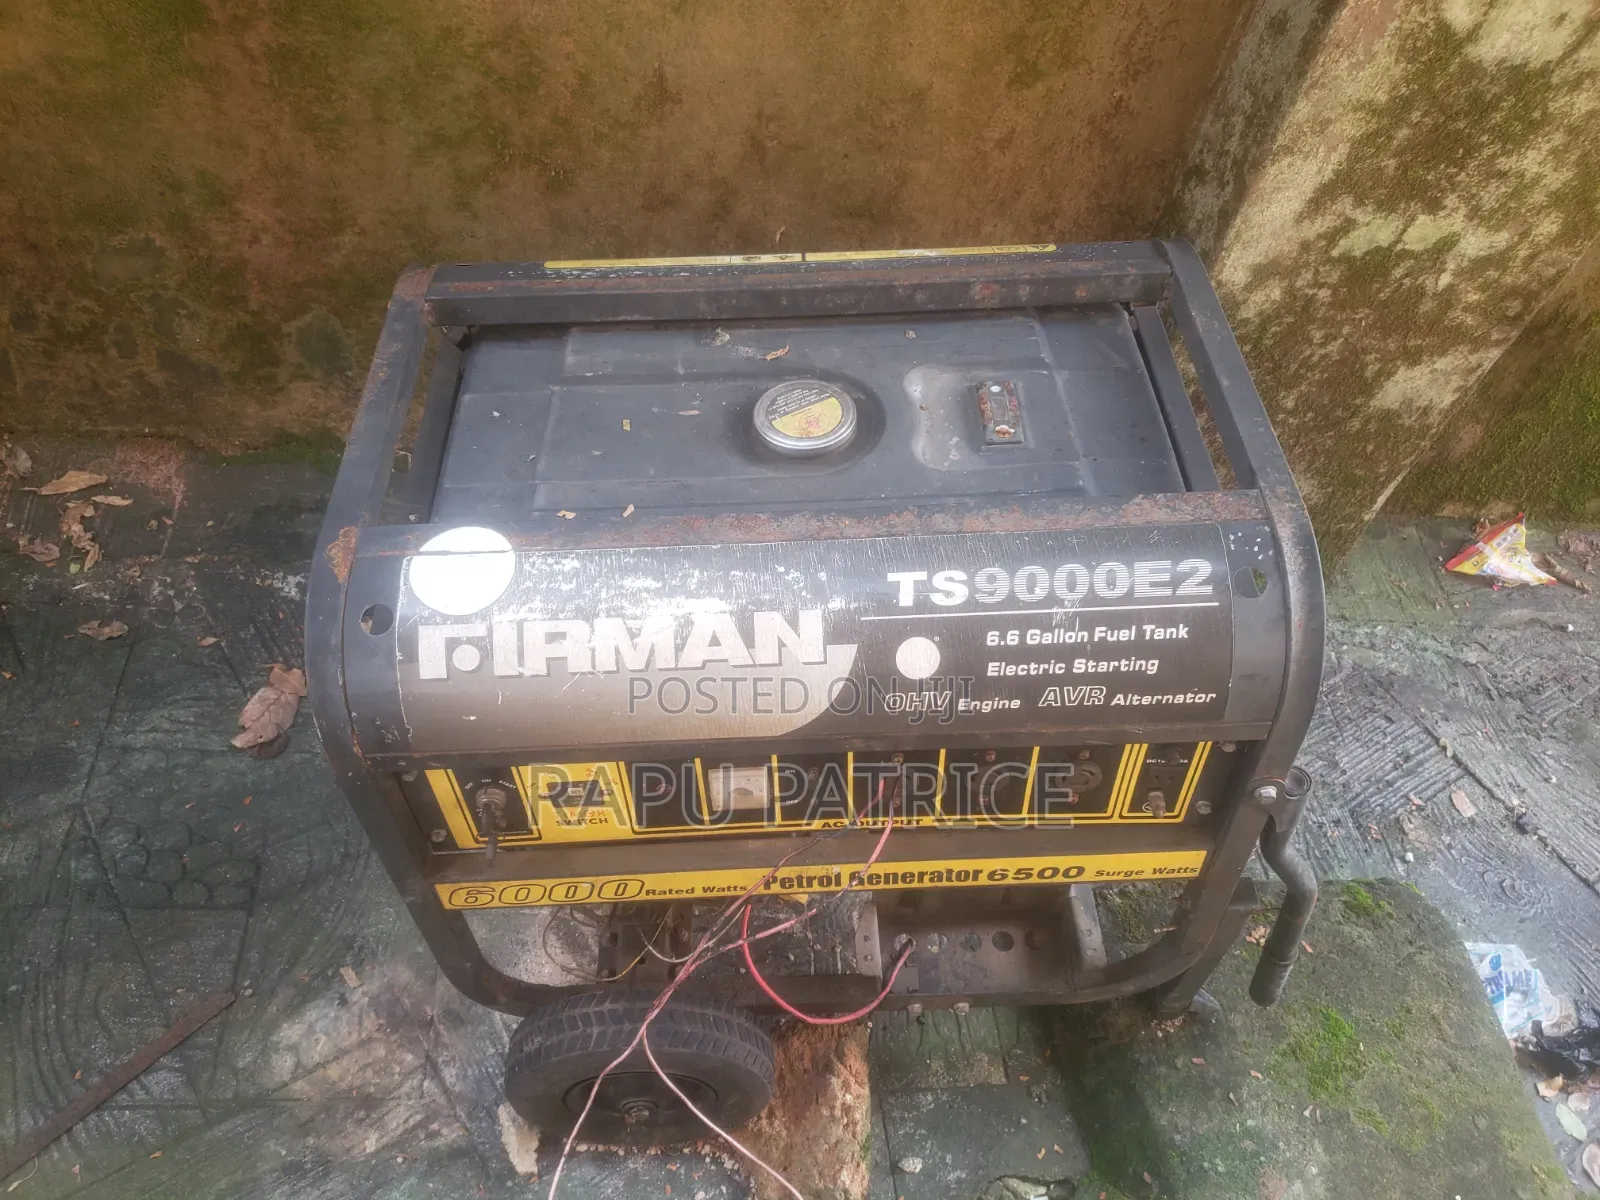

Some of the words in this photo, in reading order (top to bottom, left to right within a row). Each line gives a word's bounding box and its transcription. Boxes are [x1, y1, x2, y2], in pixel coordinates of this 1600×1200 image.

[887, 558, 1214, 607] TS9000E2
[986, 630, 1020, 646] 6.6
[1026, 628, 1089, 645] Gallon
[1093, 626, 1136, 642] Fuel
[1142, 623, 1189, 640] Tank
[986, 660, 1066, 677] Electric
[1072, 656, 1160, 674] Starting
[884, 691, 952, 712] OHV
[957, 696, 1021, 713] Engine
[1038, 685, 1107, 707] AVR
[1110, 690, 1217, 707] Alternator
[820, 820, 845, 829] AC
[448, 877, 646, 908] 6000
[645, 885, 695, 897] Rated
[701, 882, 748, 895] Watts
[762, 871, 842, 891] Petrol
[986, 865, 1086, 882] 6500
[1094, 867, 1145, 880] Surge
[1152, 864, 1199, 877] Watts
